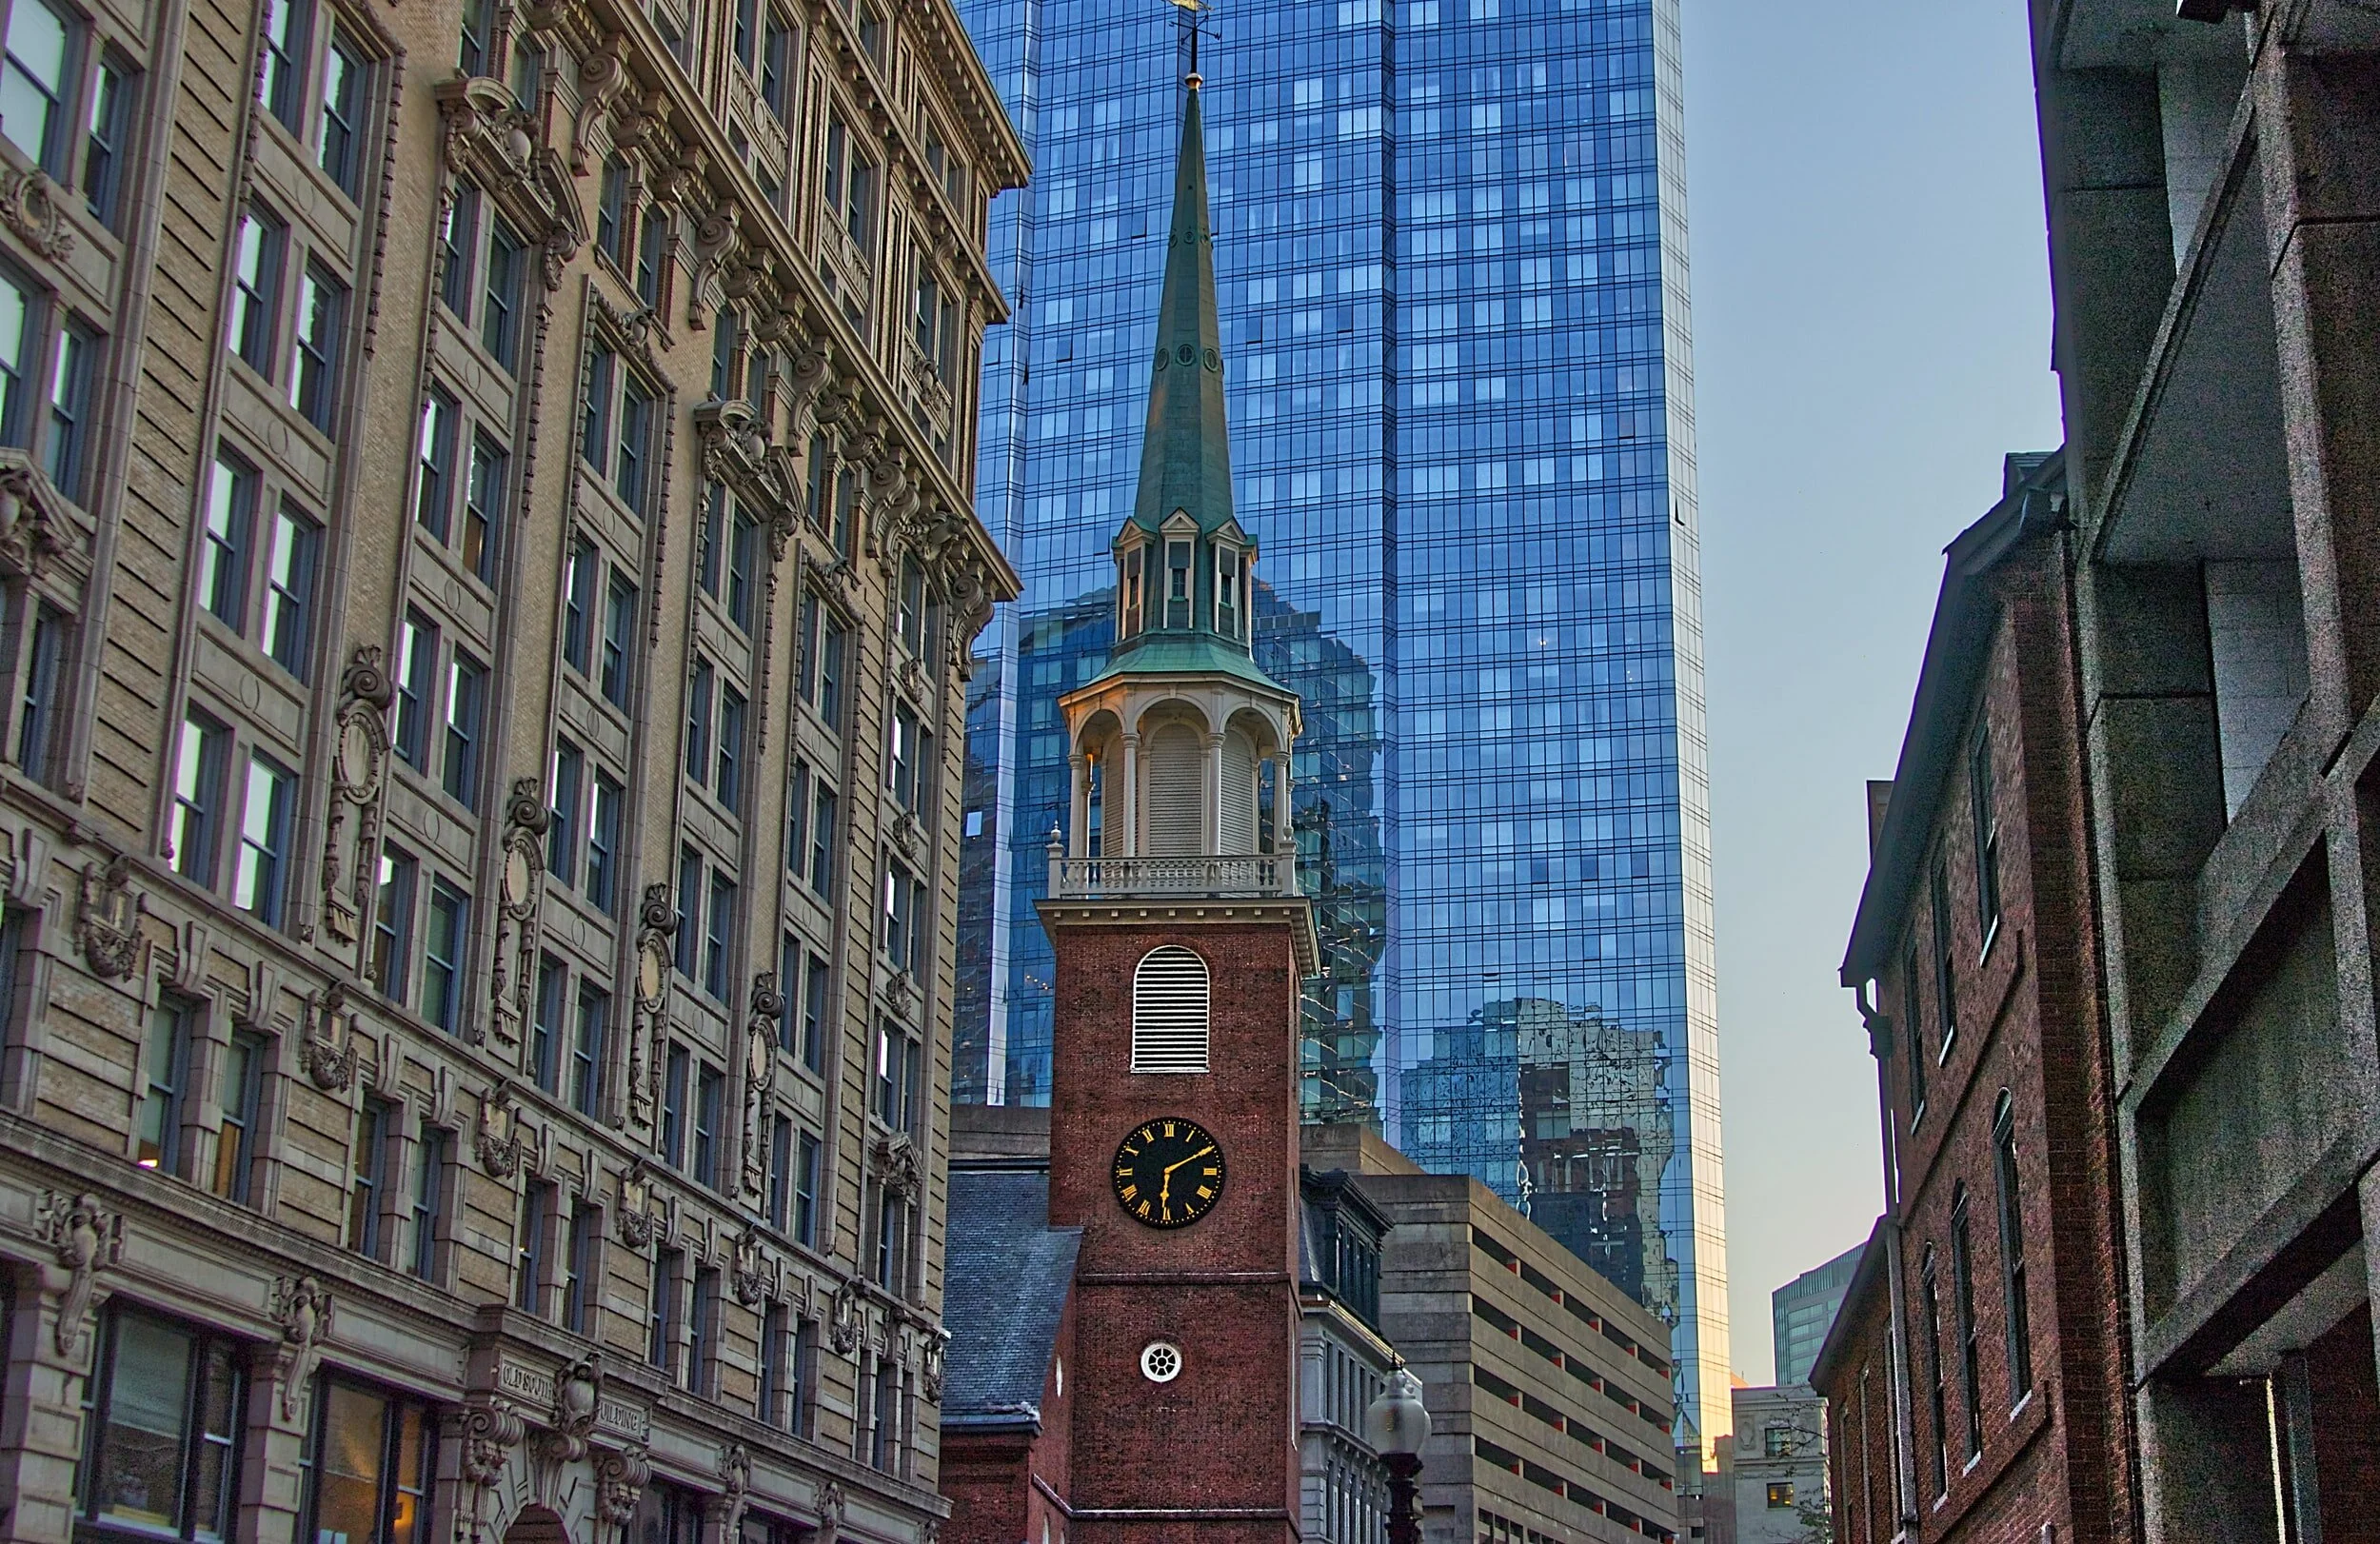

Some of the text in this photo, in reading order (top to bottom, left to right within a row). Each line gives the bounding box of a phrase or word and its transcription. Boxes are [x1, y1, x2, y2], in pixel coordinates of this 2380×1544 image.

[1164, 1123, 1175, 1138] XII
[1185, 1130, 1195, 1142] I
[1202, 1167, 1218, 1177] III
[503, 1364, 637, 1432] OLD SOUTH UILDING
